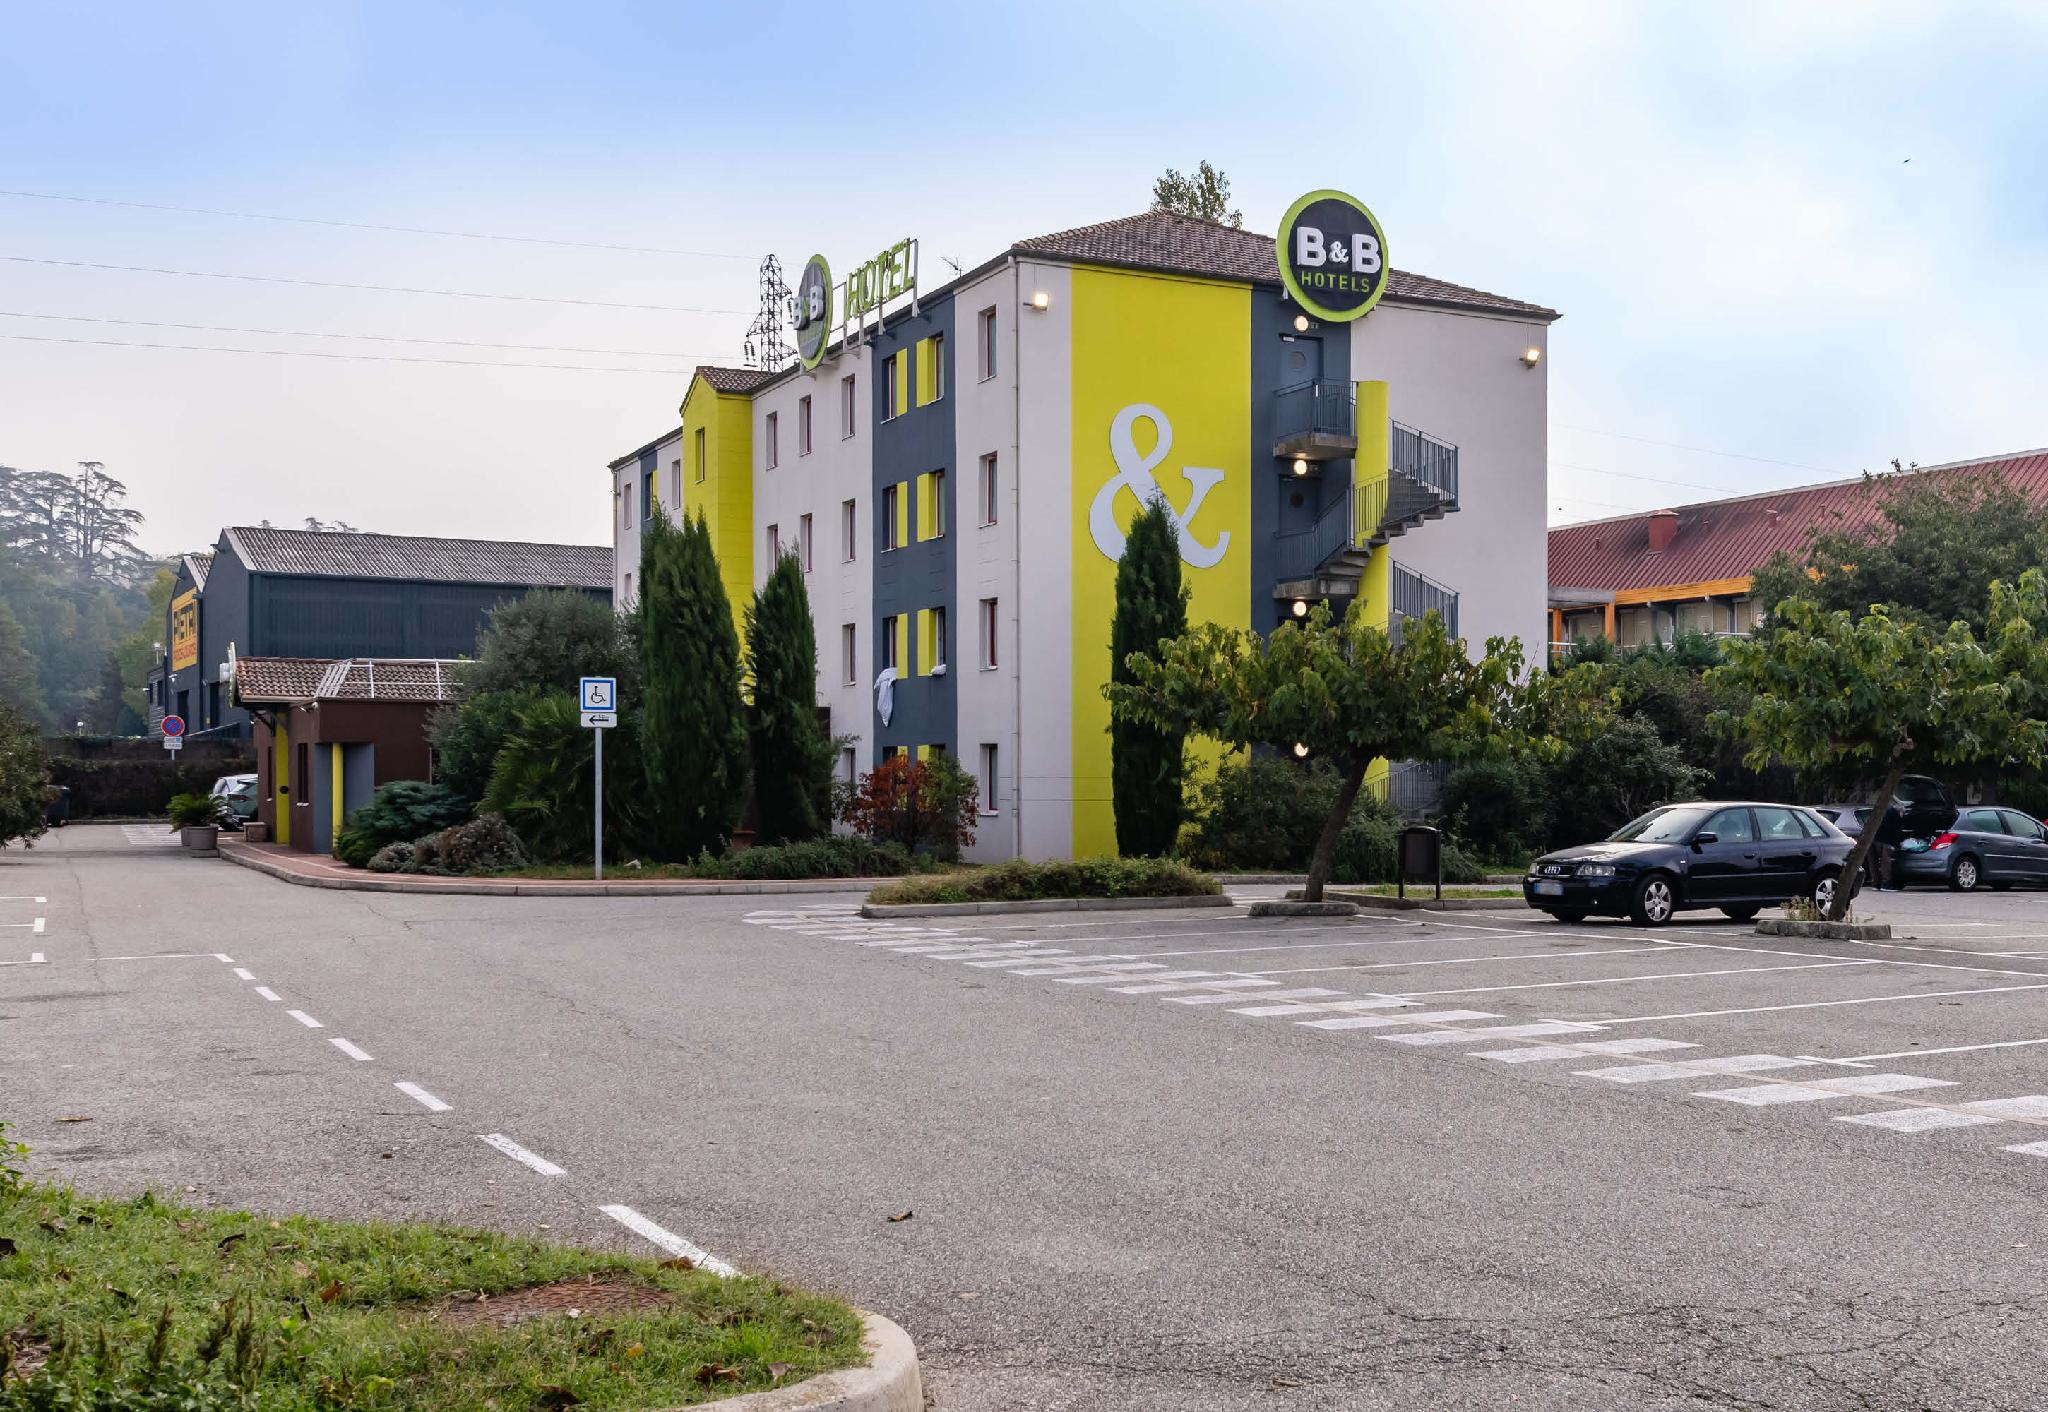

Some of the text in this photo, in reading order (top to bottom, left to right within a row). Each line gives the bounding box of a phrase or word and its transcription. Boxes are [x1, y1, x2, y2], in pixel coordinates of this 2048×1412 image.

[1296, 226, 1381, 274] B&B
[847, 238, 914, 321] HOTEL
[1301, 271, 1370, 293] HOTELS
